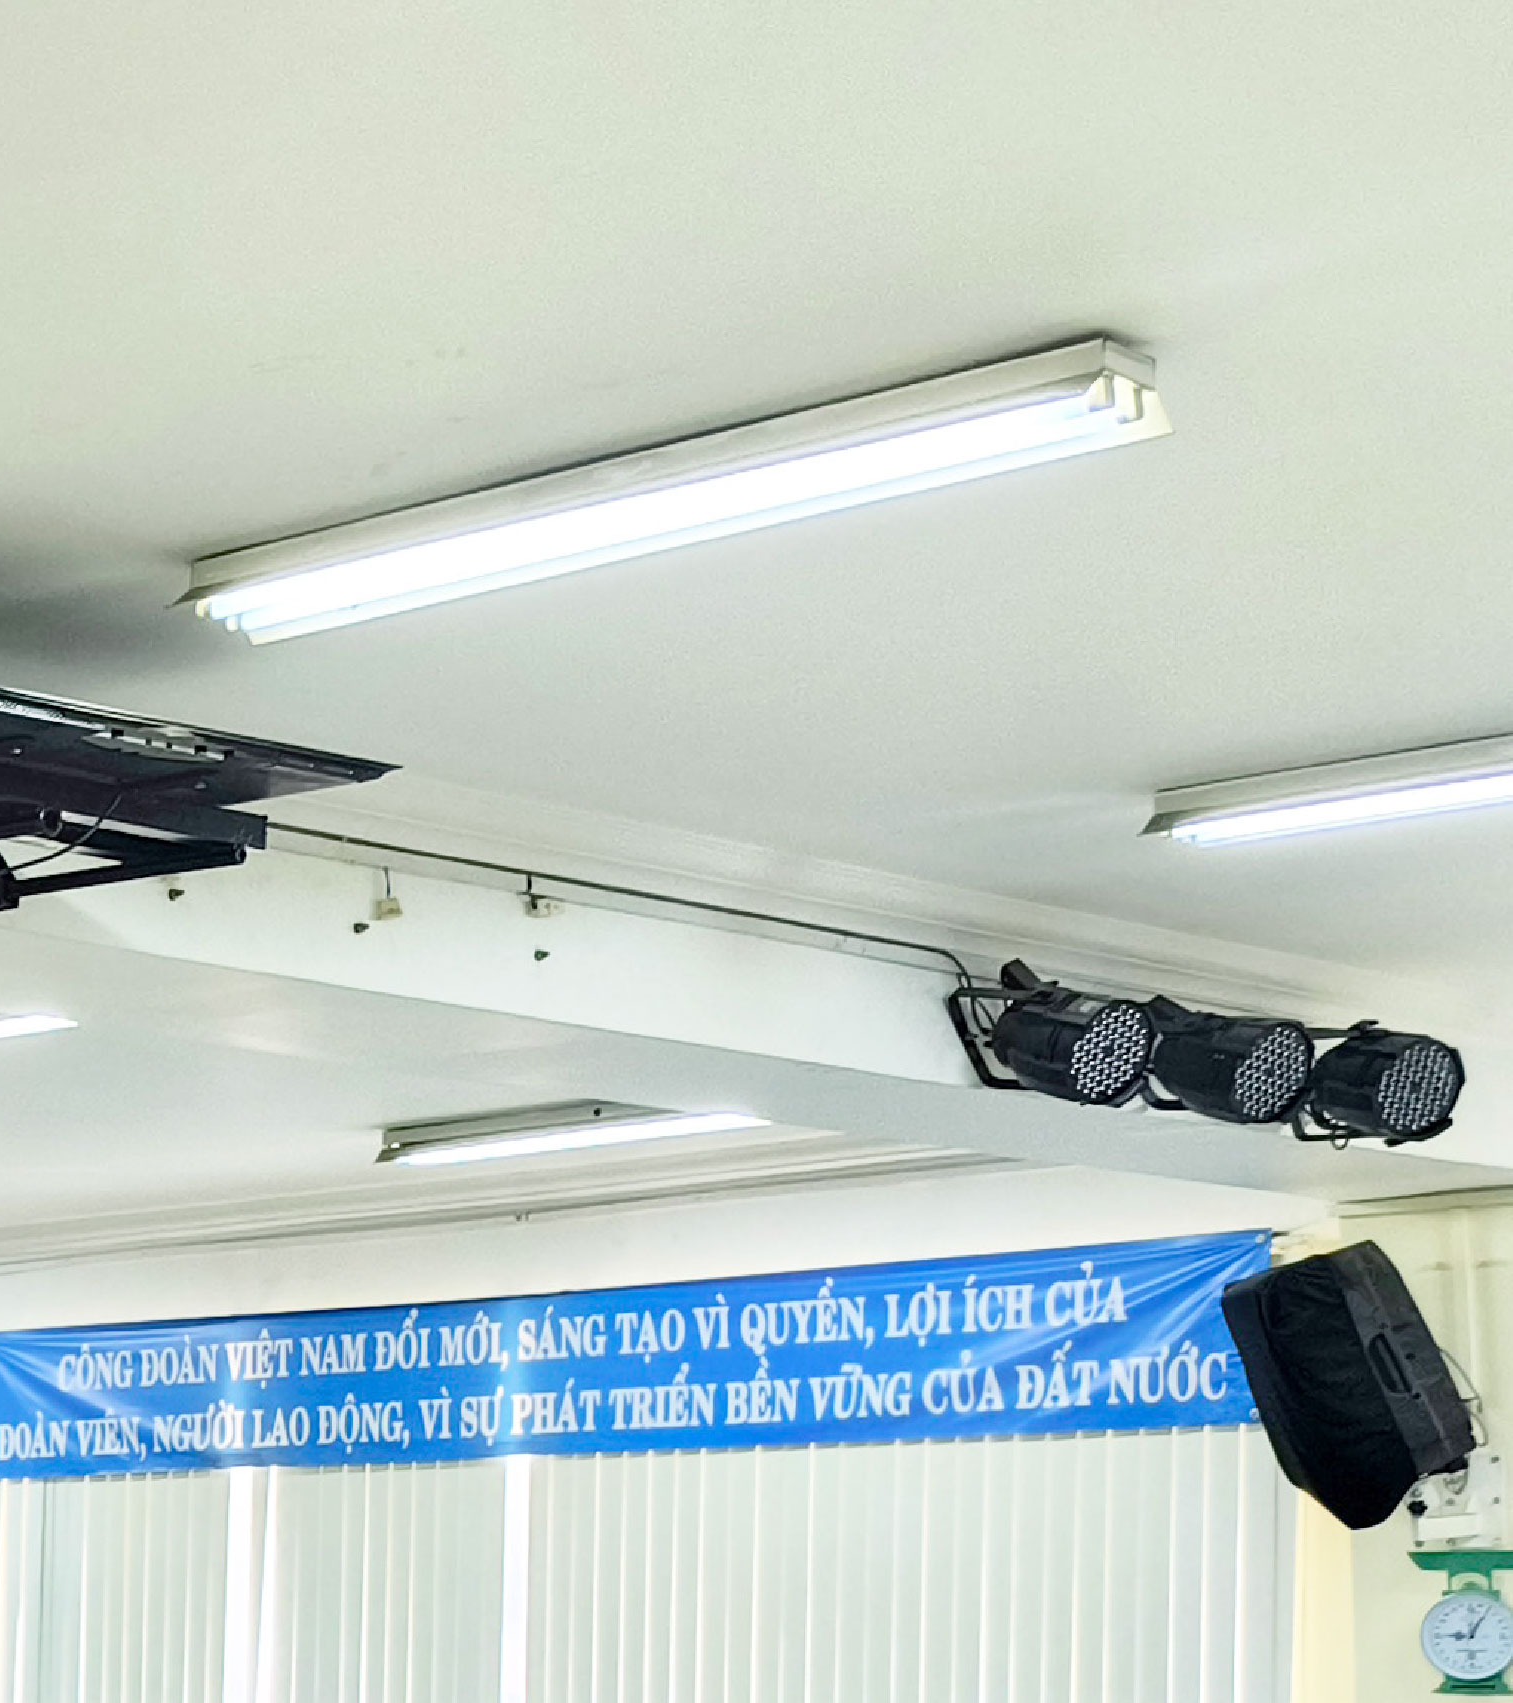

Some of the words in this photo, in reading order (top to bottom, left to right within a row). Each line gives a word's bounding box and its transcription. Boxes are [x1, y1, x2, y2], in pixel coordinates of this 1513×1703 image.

[59, 1344, 133, 1392] CÔNG
[140, 1335, 218, 1387] ĐOÀN
[225, 1328, 293, 1389] VIỆT
[299, 1333, 367, 1376] NAM
[373, 1307, 430, 1371] ĐỔI
[438, 1310, 508, 1371] MỚI,
[517, 1306, 606, 1363] SÁNG
[615, 1310, 685, 1363] TẠO
[692, 1293, 730, 1350] VÌ
[739, 1276, 874, 1355] QUYỀN,
[884, 1282, 951, 1347] LỢI
[961, 1274, 1035, 1333] ÍCH
[1044, 1261, 1128, 1327] CỦA
[76, 1408, 148, 1461] VIÊN,
[152, 1400, 244, 1453] NGƯỜI
[252, 1406, 309, 1449] LAO
[316, 1392, 410, 1453] ĐỘNG,
[419, 1386, 452, 1440] VÌ
[460, 1385, 504, 1447] SỰ
[510, 1377, 602, 1436] PHÁT
[608, 1362, 716, 1430] TRIỂN
[725, 1356, 799, 1425] BỀN
[809, 1363, 912, 1420] VỮNG
[923, 1349, 1004, 1413] CỦA
[1015, 1340, 1100, 1409] ĐẤT
[1107, 1340, 1228, 1404] NƯỚC
